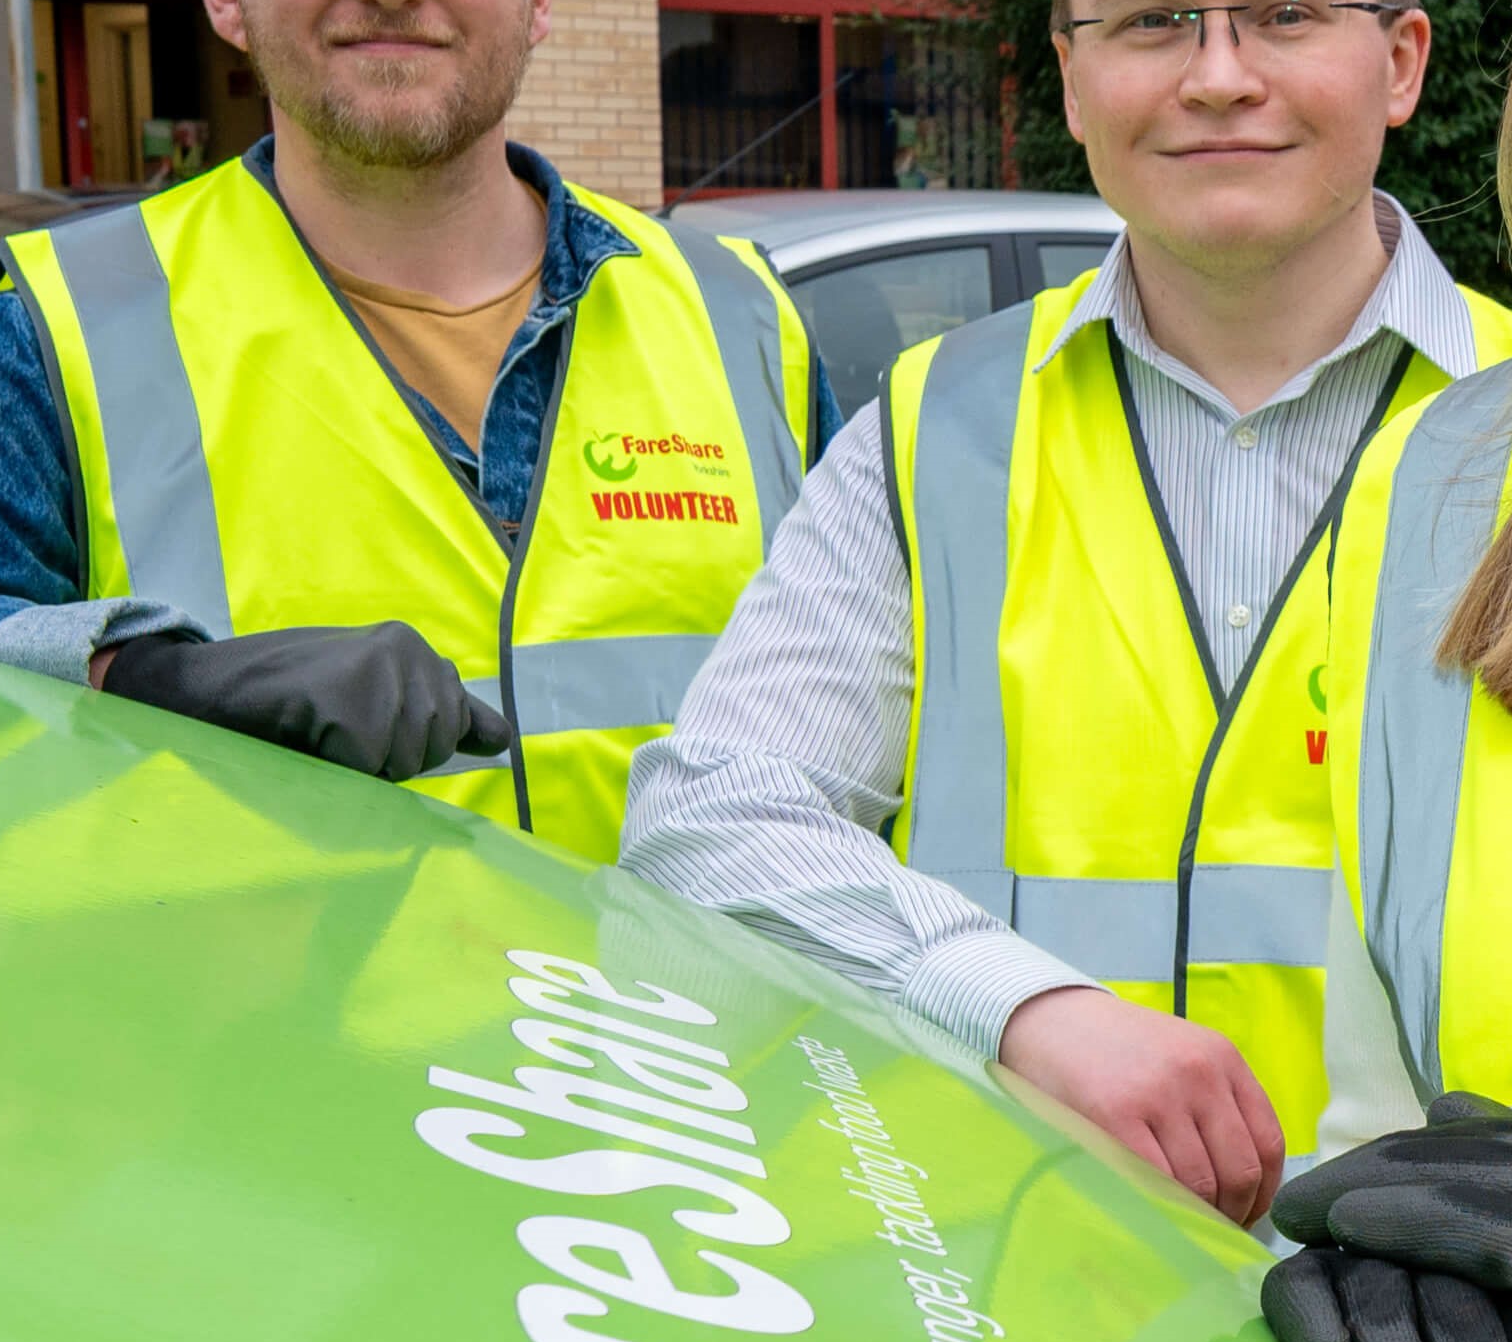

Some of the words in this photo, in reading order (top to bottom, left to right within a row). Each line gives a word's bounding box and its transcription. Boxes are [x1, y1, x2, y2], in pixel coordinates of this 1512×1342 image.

[621, 433, 724, 459] FareShare
[591, 490, 739, 525] VOLUNTEER
[791, 1035, 867, 1096] waste
[802, 1081, 895, 1150] food
[841, 1144, 948, 1256] tackling
